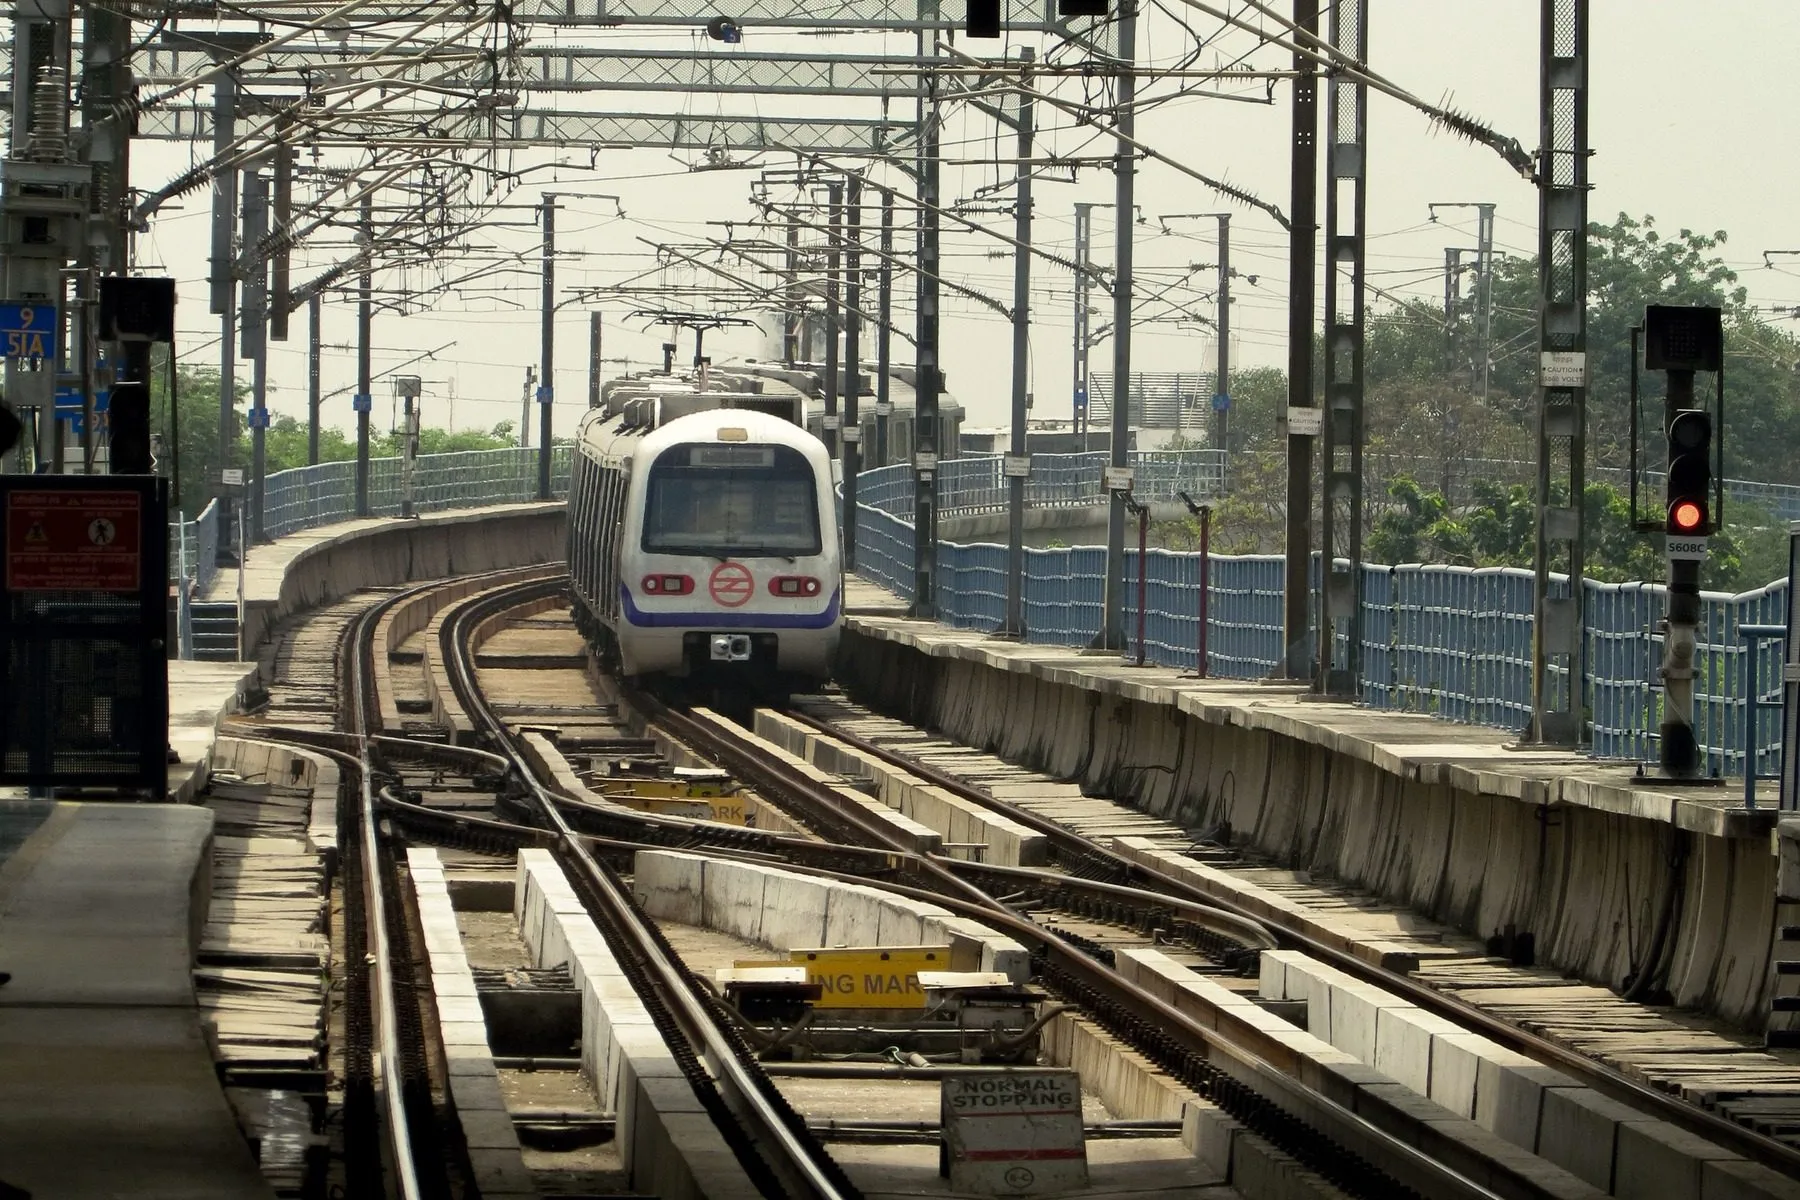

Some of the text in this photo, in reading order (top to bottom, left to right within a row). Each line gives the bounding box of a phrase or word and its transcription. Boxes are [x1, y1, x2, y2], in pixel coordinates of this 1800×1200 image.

[20, 307, 34, 329] 9
[1668, 542, 1705, 553] S608C
[864, 974, 921, 994] MAR
[963, 1078, 1061, 1093] NORMAL
[953, 1092, 1073, 1108] STOPPING
